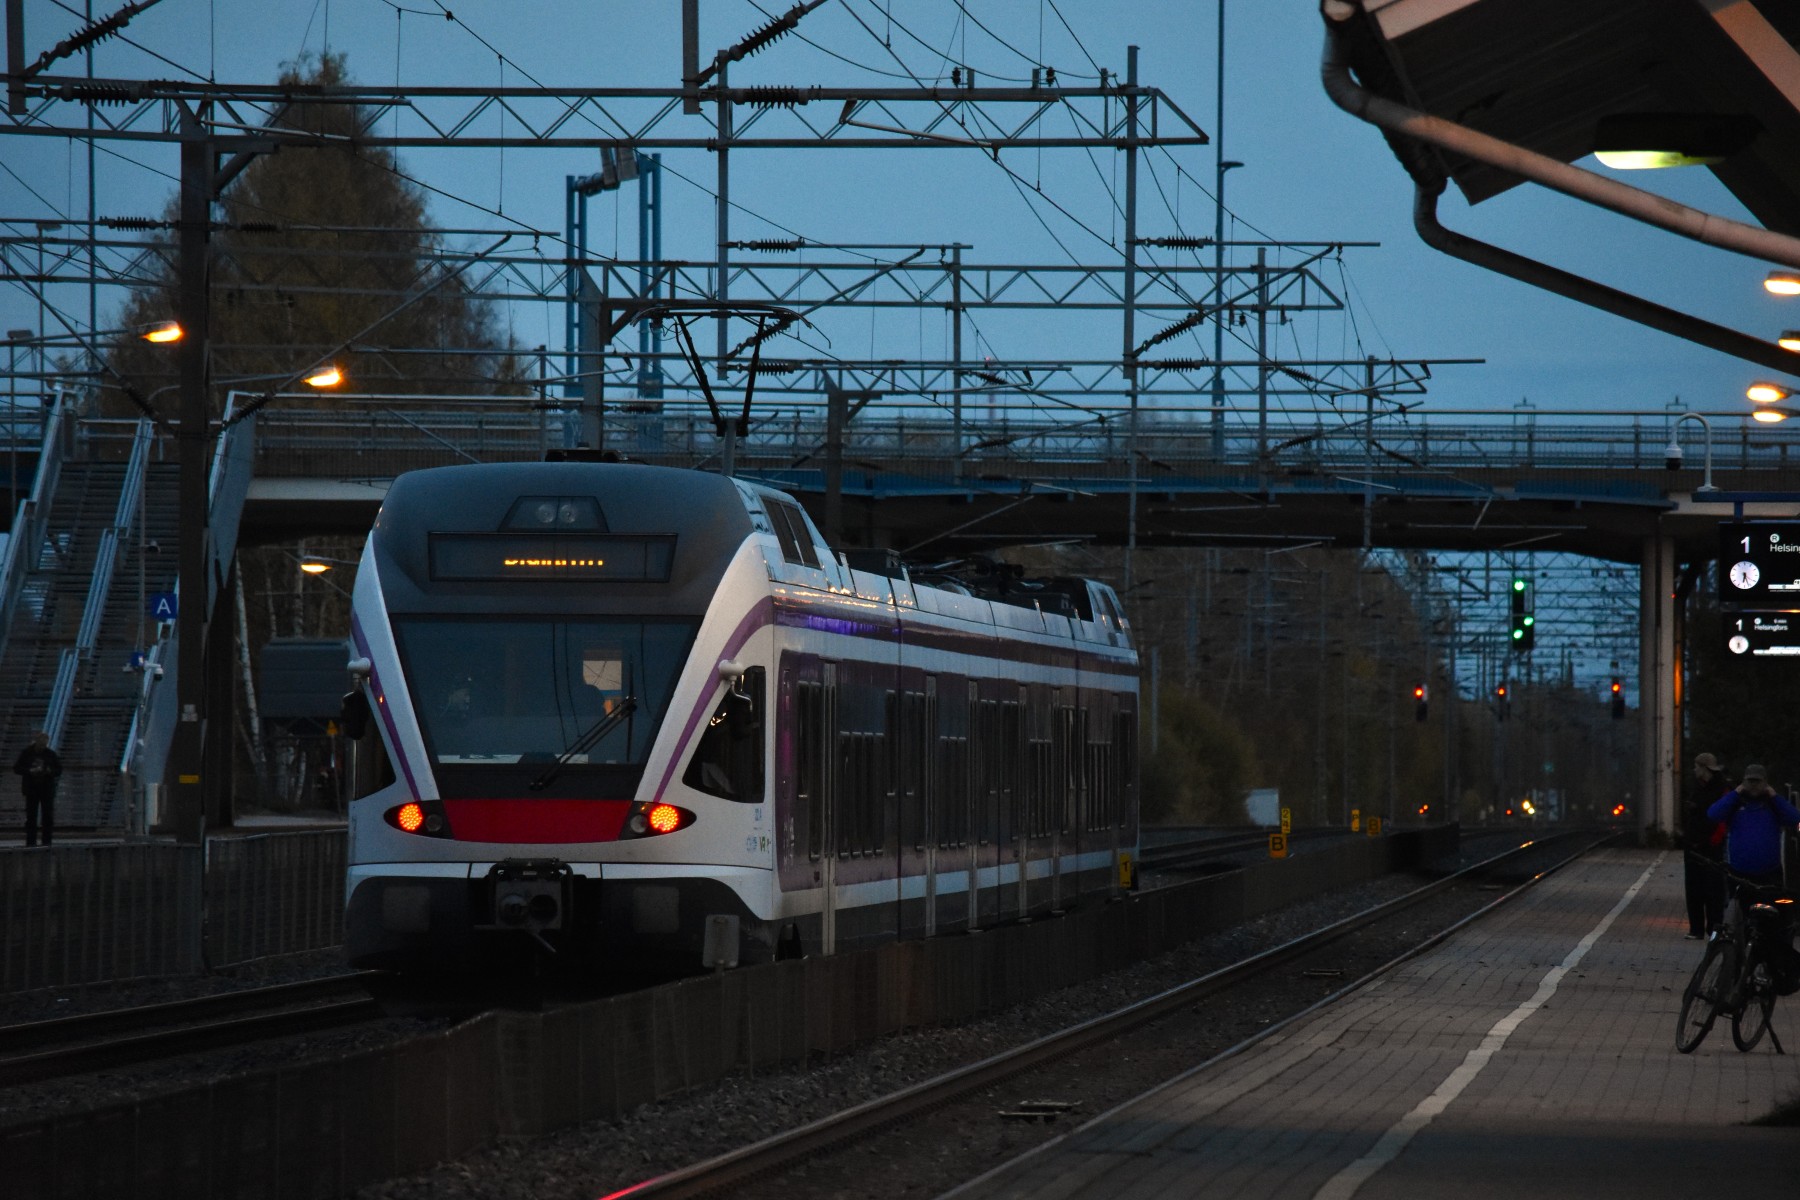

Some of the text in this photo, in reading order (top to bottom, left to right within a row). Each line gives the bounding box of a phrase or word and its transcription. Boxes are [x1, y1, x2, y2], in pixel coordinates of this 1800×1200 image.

[1741, 536, 1750, 554] 1
[156, 598, 171, 614] A
[1736, 619, 1743, 632] 1
[1272, 836, 1284, 852] B
